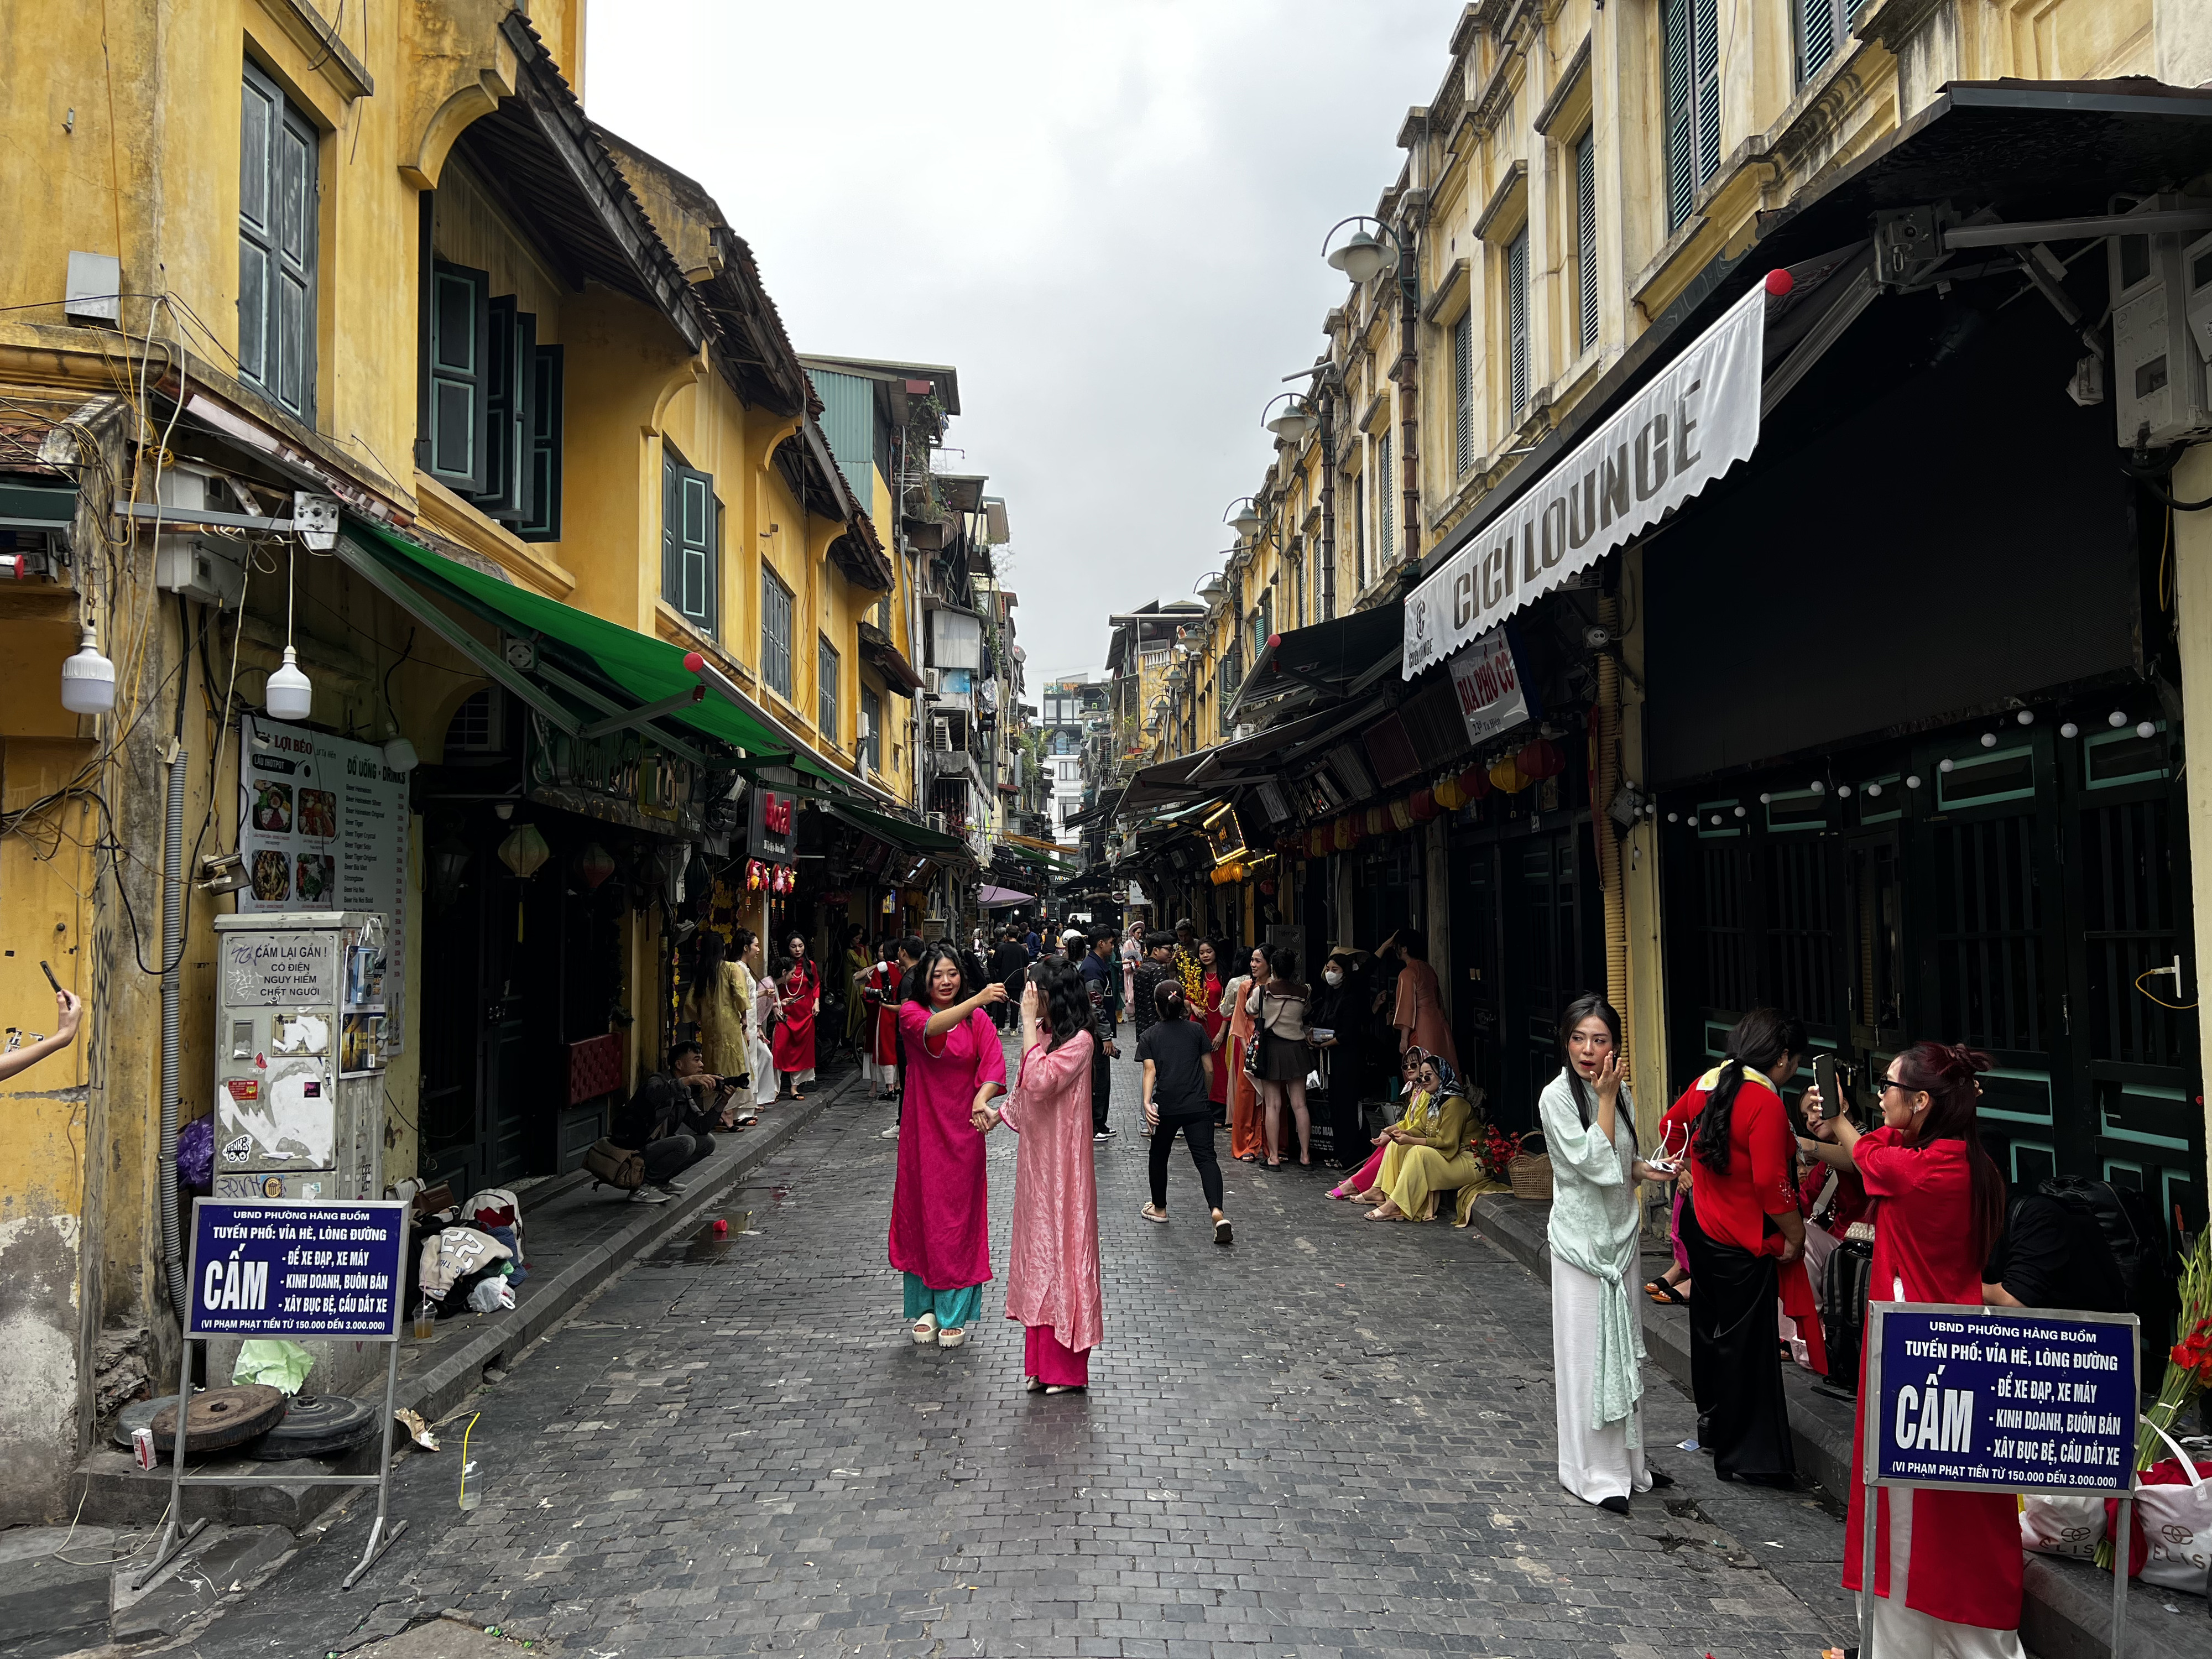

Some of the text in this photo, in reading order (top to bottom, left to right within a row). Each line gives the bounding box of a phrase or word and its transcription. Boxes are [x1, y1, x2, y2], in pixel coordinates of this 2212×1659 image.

[1453, 379, 1702, 630] CICI LOUNGE
[1457, 675, 1480, 716] BIA
[1473, 643, 1498, 706] PHỐ
[347, 754, 358, 775] ĐỒ
[382, 766, 406, 785] DRINKS
[1532, 817, 1539, 830] 23
[354, 853, 363, 862] Tiger
[255, 943, 278, 958] CẤM
[281, 947, 296, 960] LẠI
[264, 972, 316, 984] NGUY HIỂM
[271, 961, 310, 973] CÓ ĐIỆN
[260, 987, 320, 996] CHẾT NGƯỜI
[233, 1211, 262, 1219] UBND
[264, 1211, 307, 1220] PHƯỜNG
[309, 1211, 338, 1220] HÀNG
[213, 1223, 387, 1241] TUYẾN PHỐ: VỈA HÈ, LÒNG ĐƯỜNG
[288, 1245, 300, 1265] ĐỂ
[300, 1251, 313, 1265] XE
[314, 1251, 334, 1269] ĐẠP,
[336, 1251, 348, 1266] XE
[349, 1249, 369, 1266] MÁY
[203, 1243, 269, 1311] CẤM
[285, 1274, 307, 1289] KINH
[309, 1274, 342, 1291] DOANH,
[344, 1272, 368, 1289] BUÔN
[369, 1272, 388, 1290] BÁN
[283, 1295, 302, 1312] XÂY
[303, 1297, 321, 1315] BỤC
[322, 1295, 336, 1316] BỆ,
[357, 1293, 374, 1313] DẮT
[375, 1298, 388, 1313] XE
[201, 1319, 212, 1329] (VI
[213, 1320, 237, 1331] PHẠM
[239, 1320, 261, 1331] PHẠT
[296, 1321, 326, 1329] 150.000
[327, 1317, 345, 1329] ĐẾN
[346, 1321, 385, 1331] 3.000.000)
[1929, 1321, 2096, 1343] UBND PHƯỜNG HÀNG BUỒM
[1905, 1338, 2118, 1371] TUYẾN PHỐ: VỈA HÈ, LÒNG ĐƯỜNG
[1998, 1371, 2012, 1398] ĐỂ
[2014, 1379, 2028, 1399] XE
[2030, 1380, 2054, 1404] ĐẠP,
[2057, 1382, 2071, 1402] XE
[2073, 1380, 2097, 1404] MÁY
[1896, 1365, 1974, 1453] CẤM
[1996, 1409, 2022, 1430] KINH
[2025, 1411, 2064, 1434] DOANH,
[2067, 1411, 2096, 1435] BUÔN
[2099, 1412, 2121, 1436] BÁN
[1993, 1437, 2015, 1459] XÂY
[2017, 1441, 2038, 1464] BỤC
[2041, 1442, 2058, 1466] BỆ,
[2060, 1437, 2082, 1463] CẦU
[2084, 1439, 2104, 1465] DẮT
[2105, 1446, 2121, 1466] XE
[1892, 1462, 2117, 1489] (VI PHẠM PHẠT TIỀN TỪ 150.000 ĐẾN 3.000.000)
